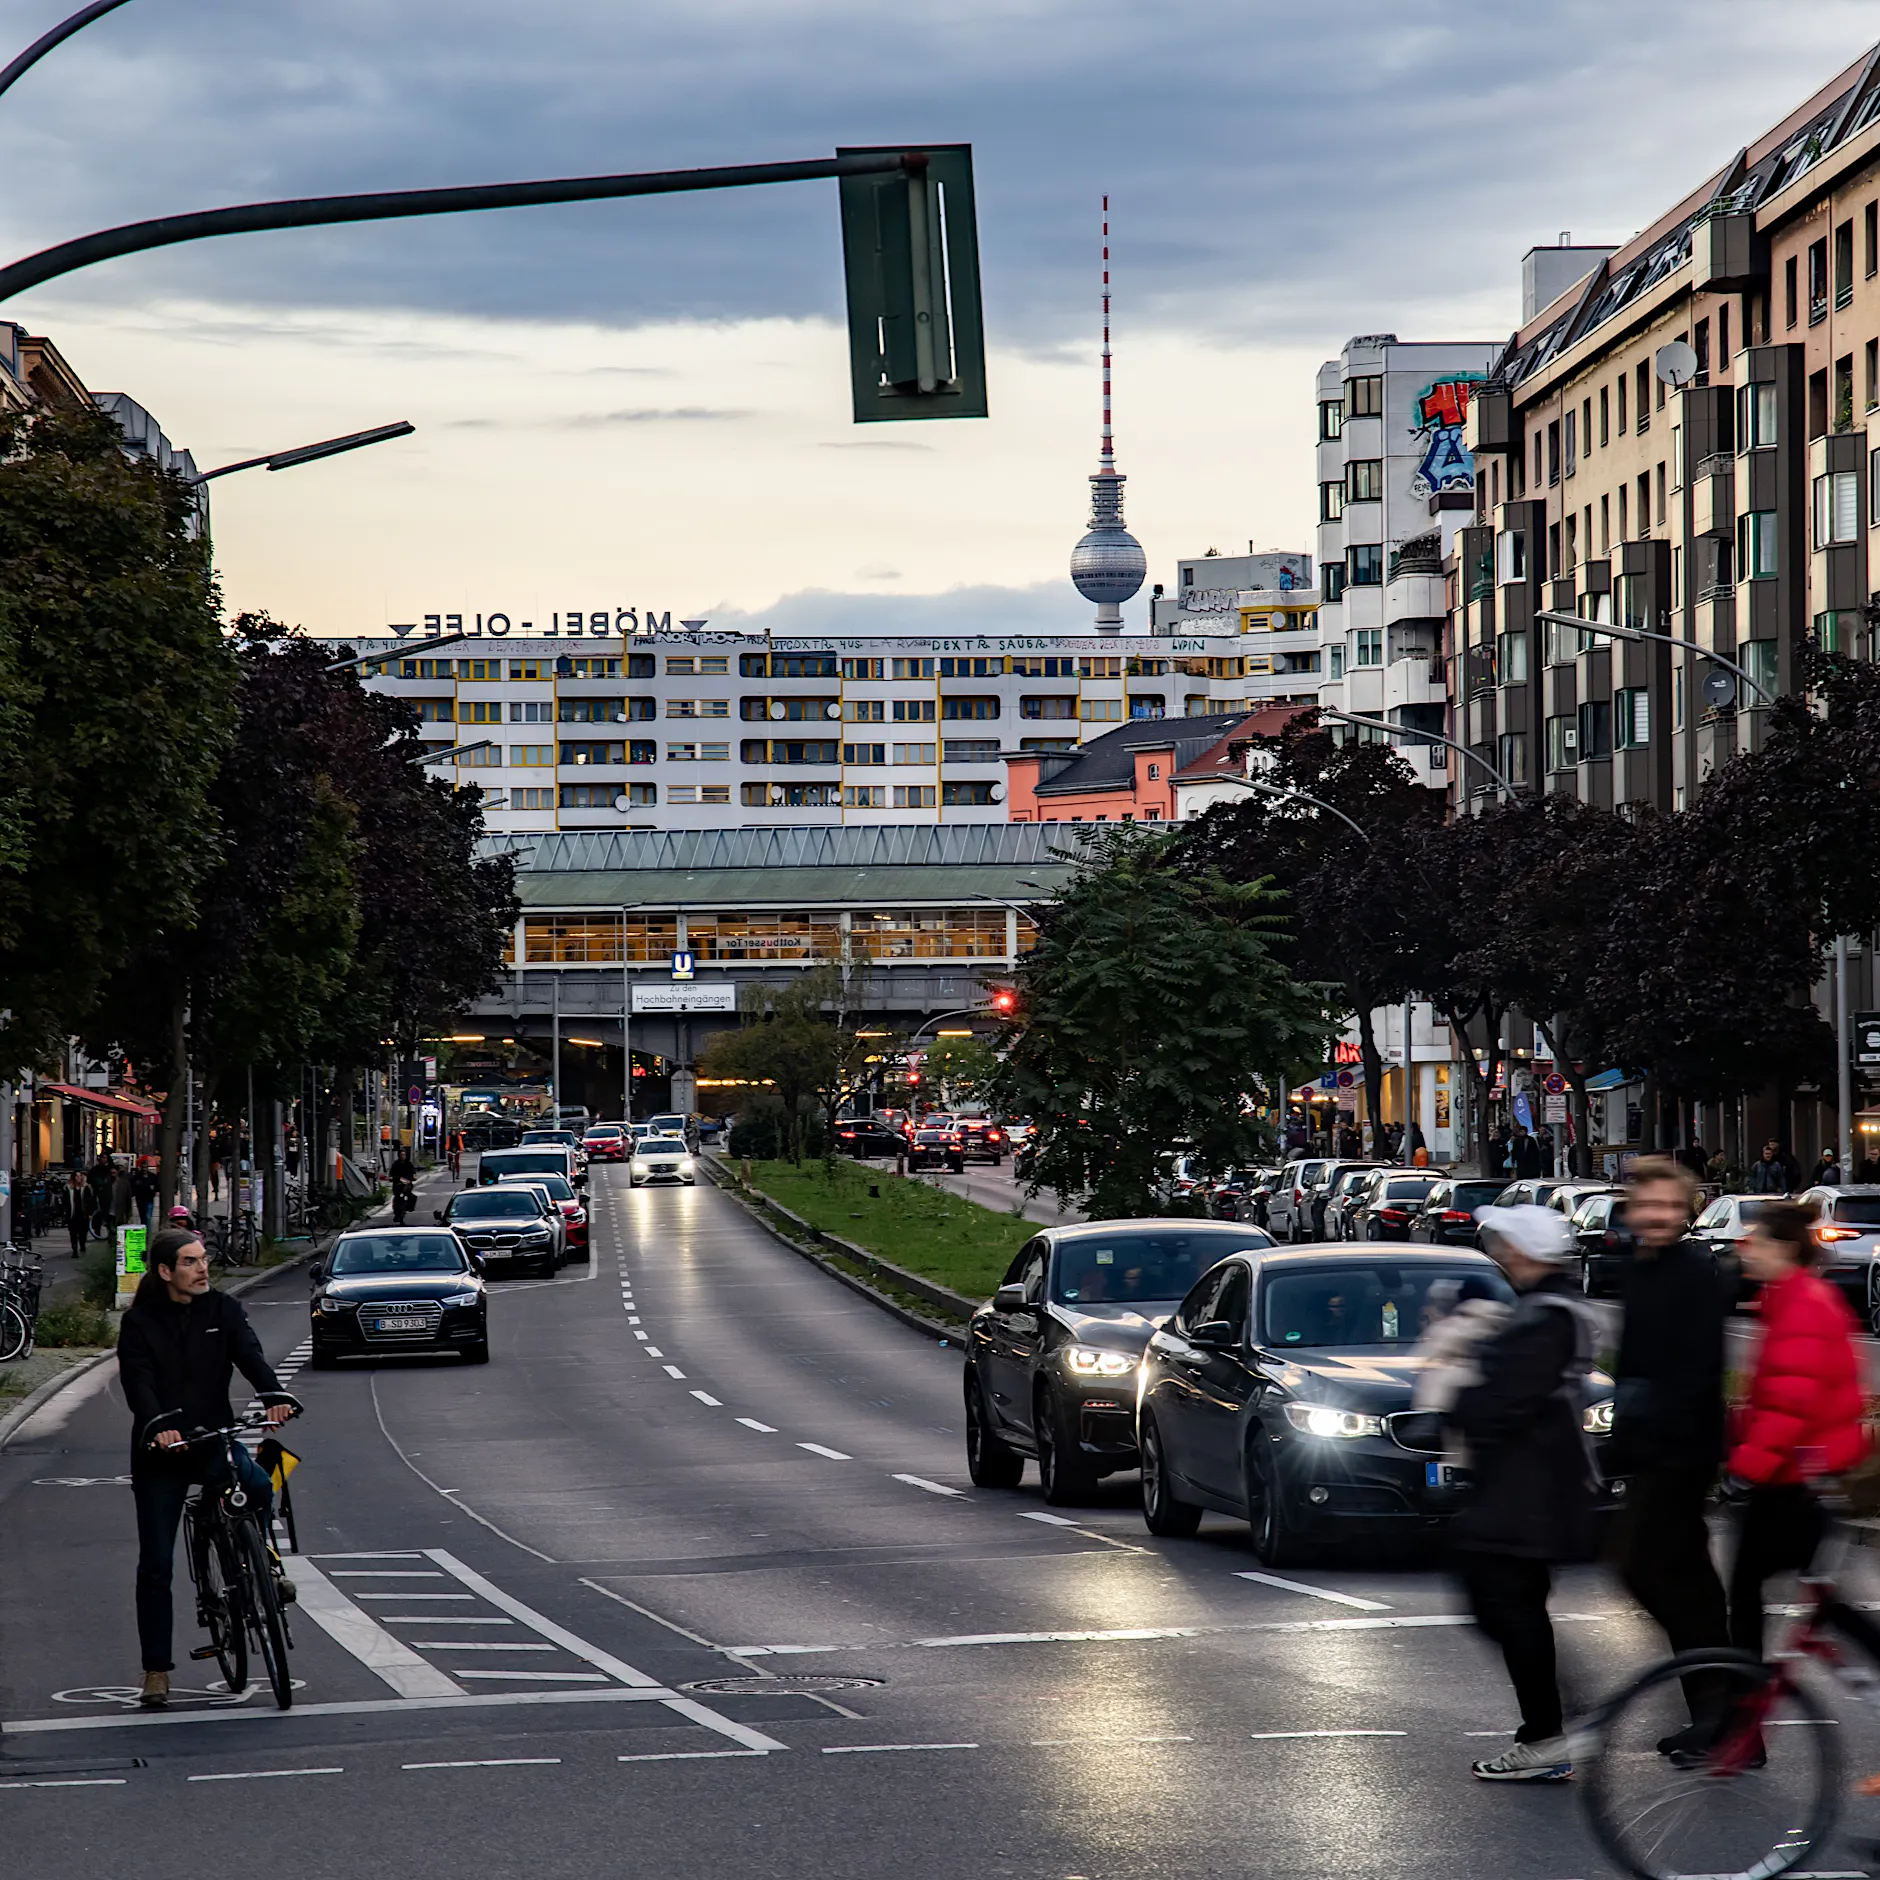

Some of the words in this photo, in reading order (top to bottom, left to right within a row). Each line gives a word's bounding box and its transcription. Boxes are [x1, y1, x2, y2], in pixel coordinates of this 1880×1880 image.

[674, 954, 692, 972] U
[670, 984, 680, 992] Zu
[682, 983, 698, 992] den
[636, 994, 732, 1006] Hochbahneingängen
[380, 1320, 386, 1329] B
[391, 1319, 403, 1328] SD
[403, 1318, 425, 1328] 9303
